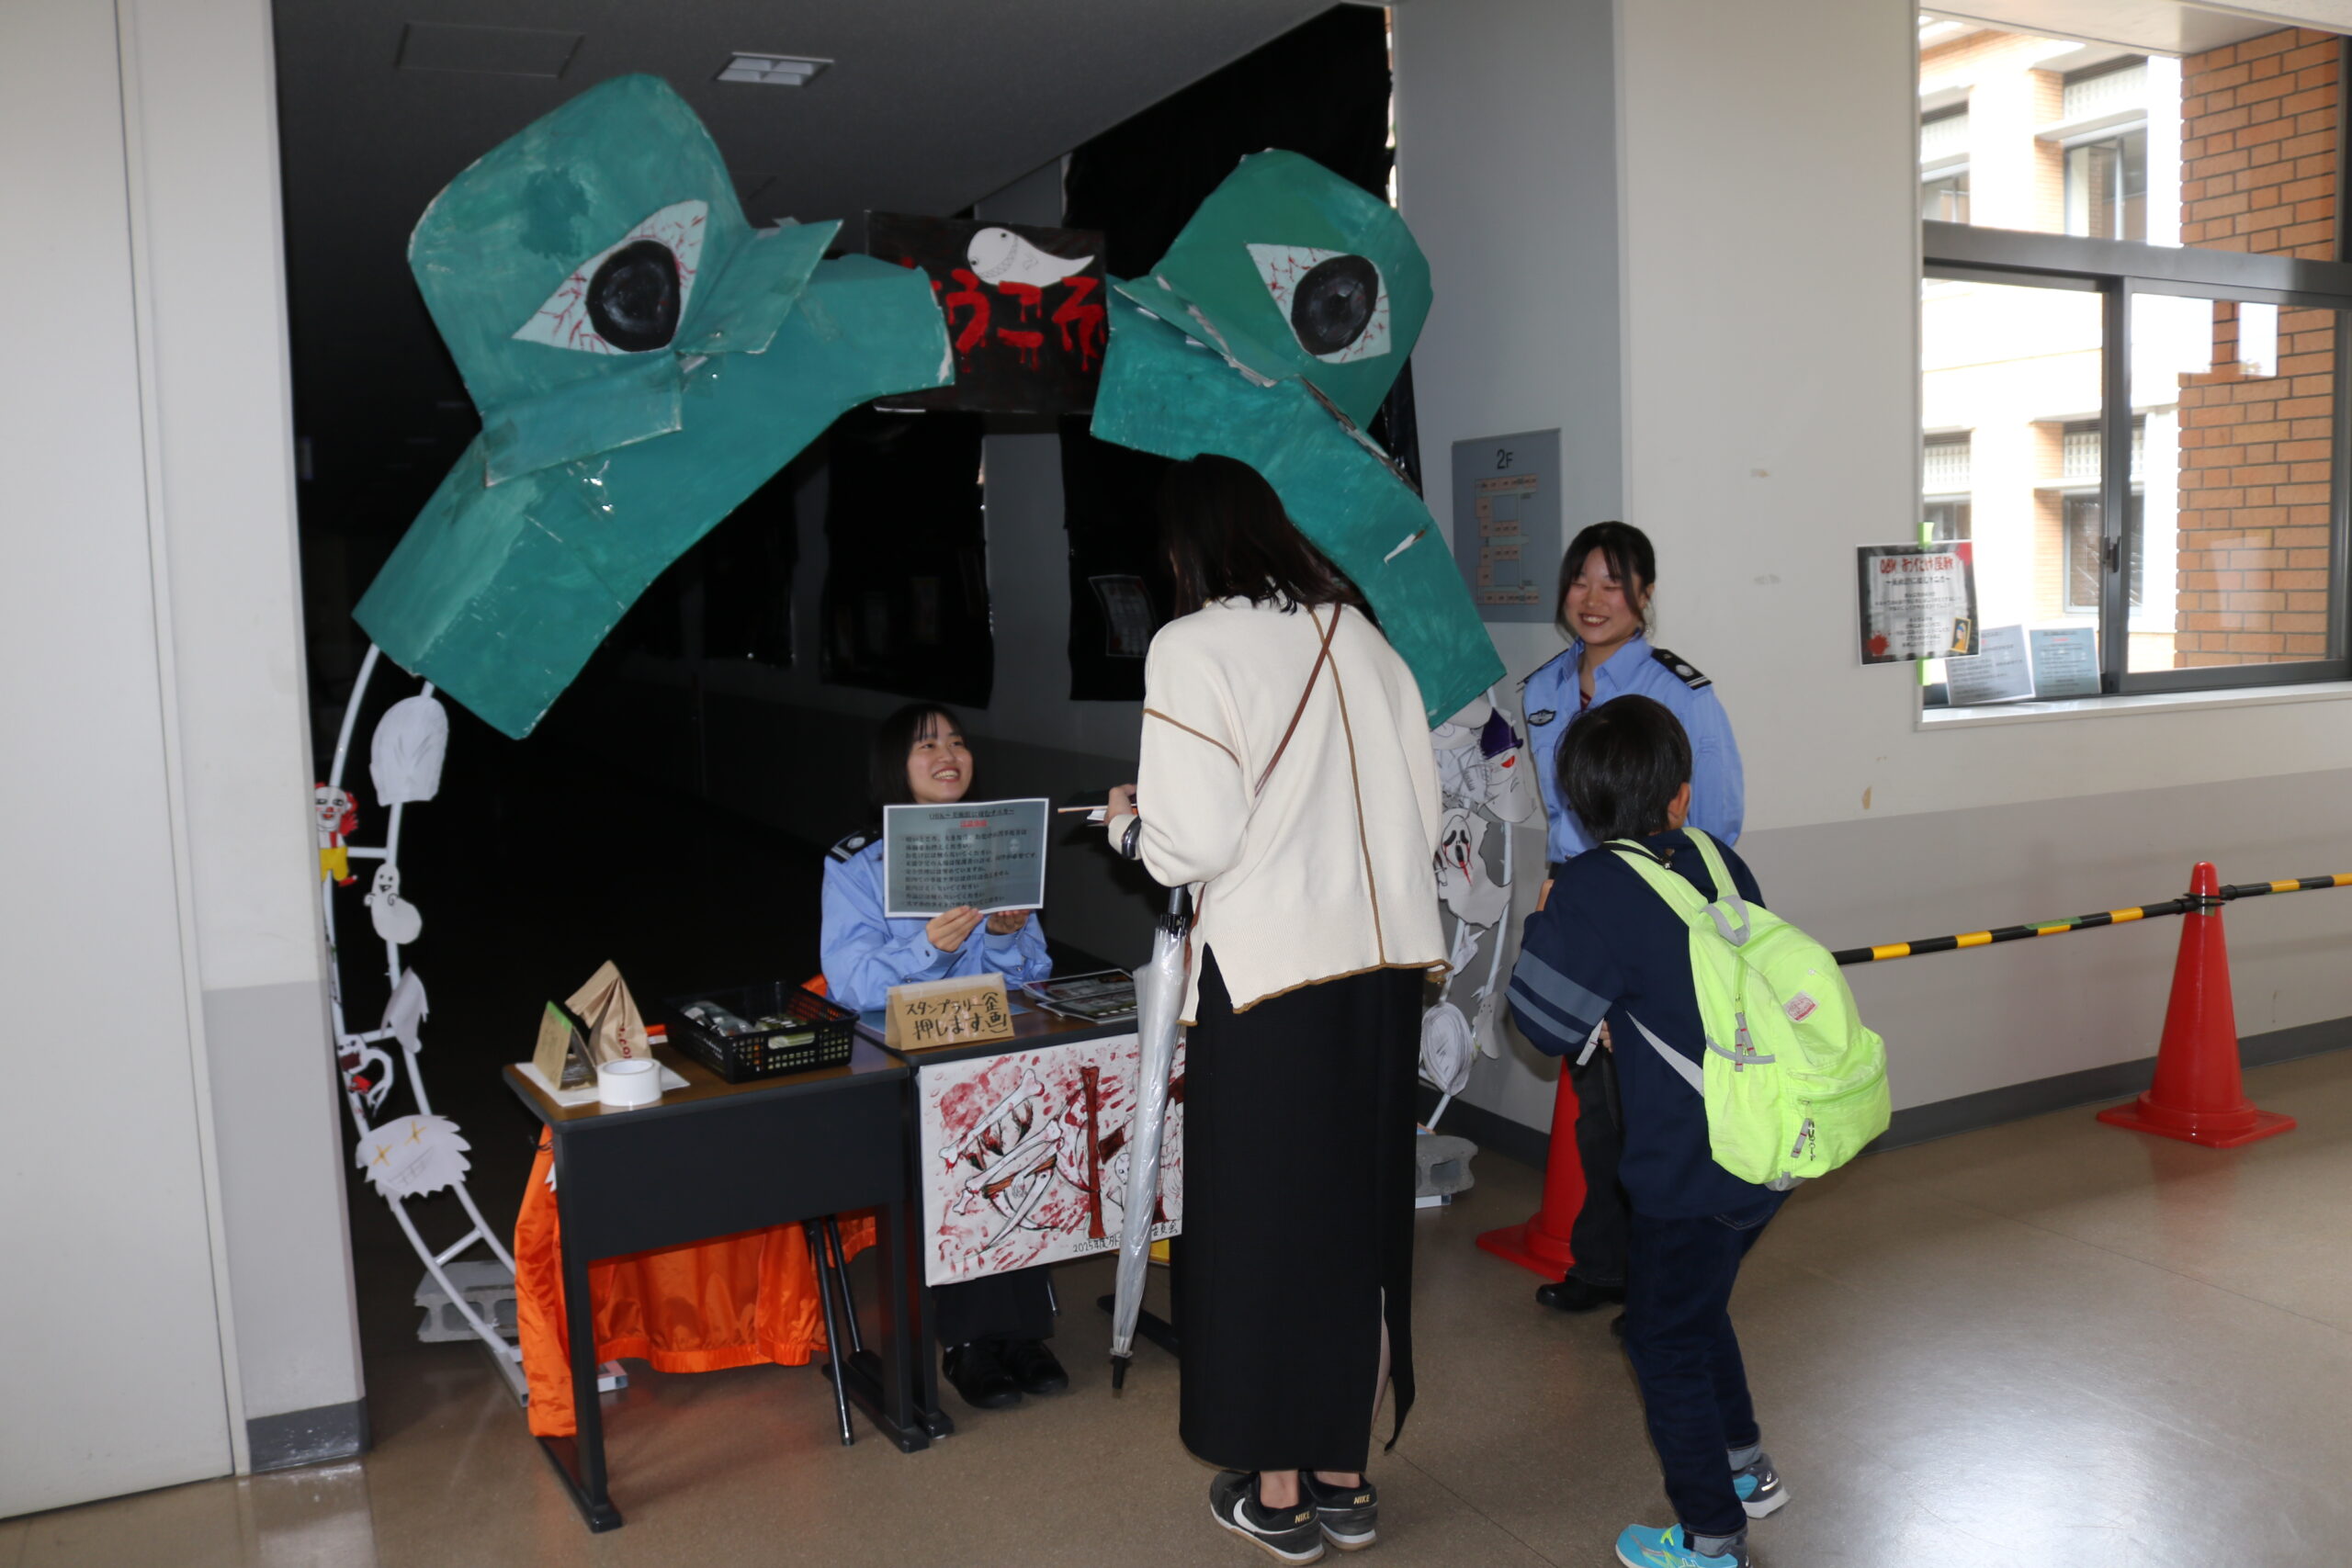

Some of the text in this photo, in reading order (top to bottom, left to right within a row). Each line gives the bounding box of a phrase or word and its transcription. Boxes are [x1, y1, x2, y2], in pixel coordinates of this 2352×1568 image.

[901, 256, 1105, 372] うこそ
[1497, 448, 1513, 469] 2F
[905, 998, 983, 1016] スタンプラリー
[1353, 1495, 1370, 1505] NIKE
[1295, 1511, 1310, 1523] NIKE
